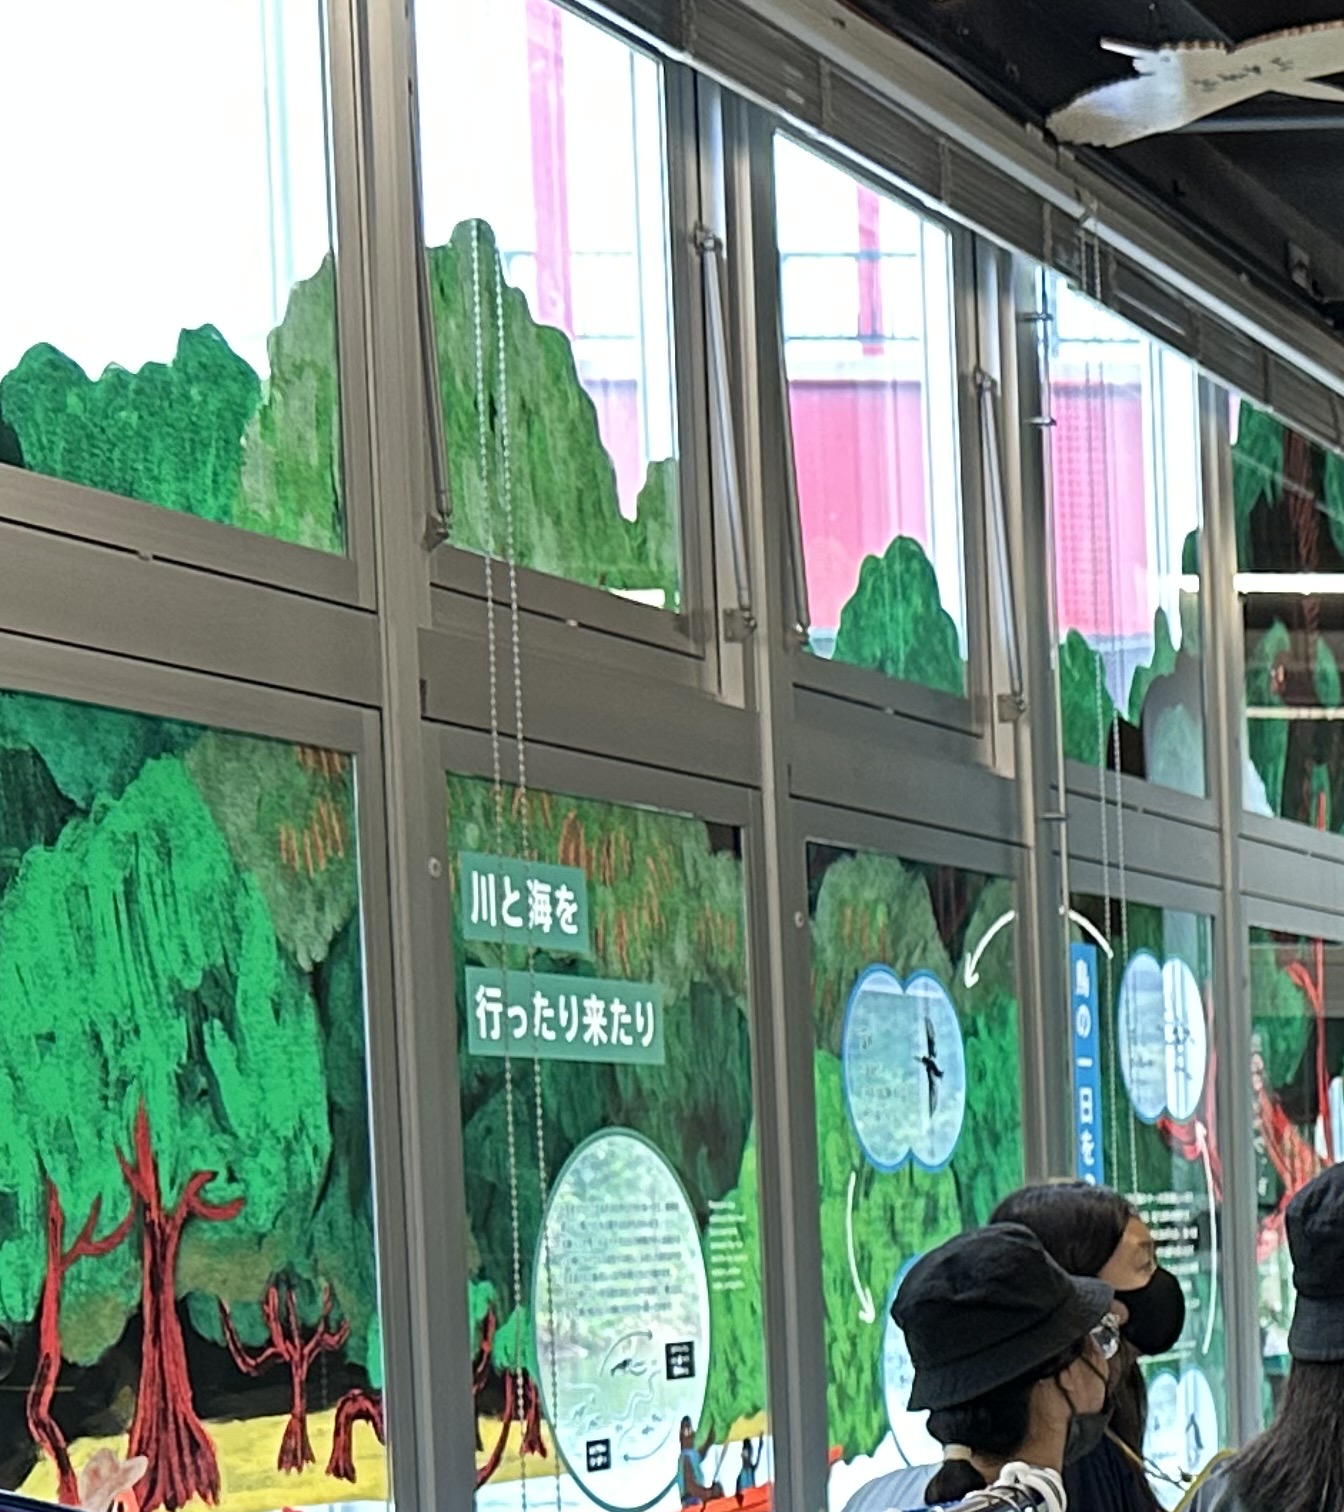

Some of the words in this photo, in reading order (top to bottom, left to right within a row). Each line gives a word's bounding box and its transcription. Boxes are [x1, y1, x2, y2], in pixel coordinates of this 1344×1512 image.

[471, 870, 579, 934] 川と海を
[475, 984, 656, 1047] 行ったり来たり
